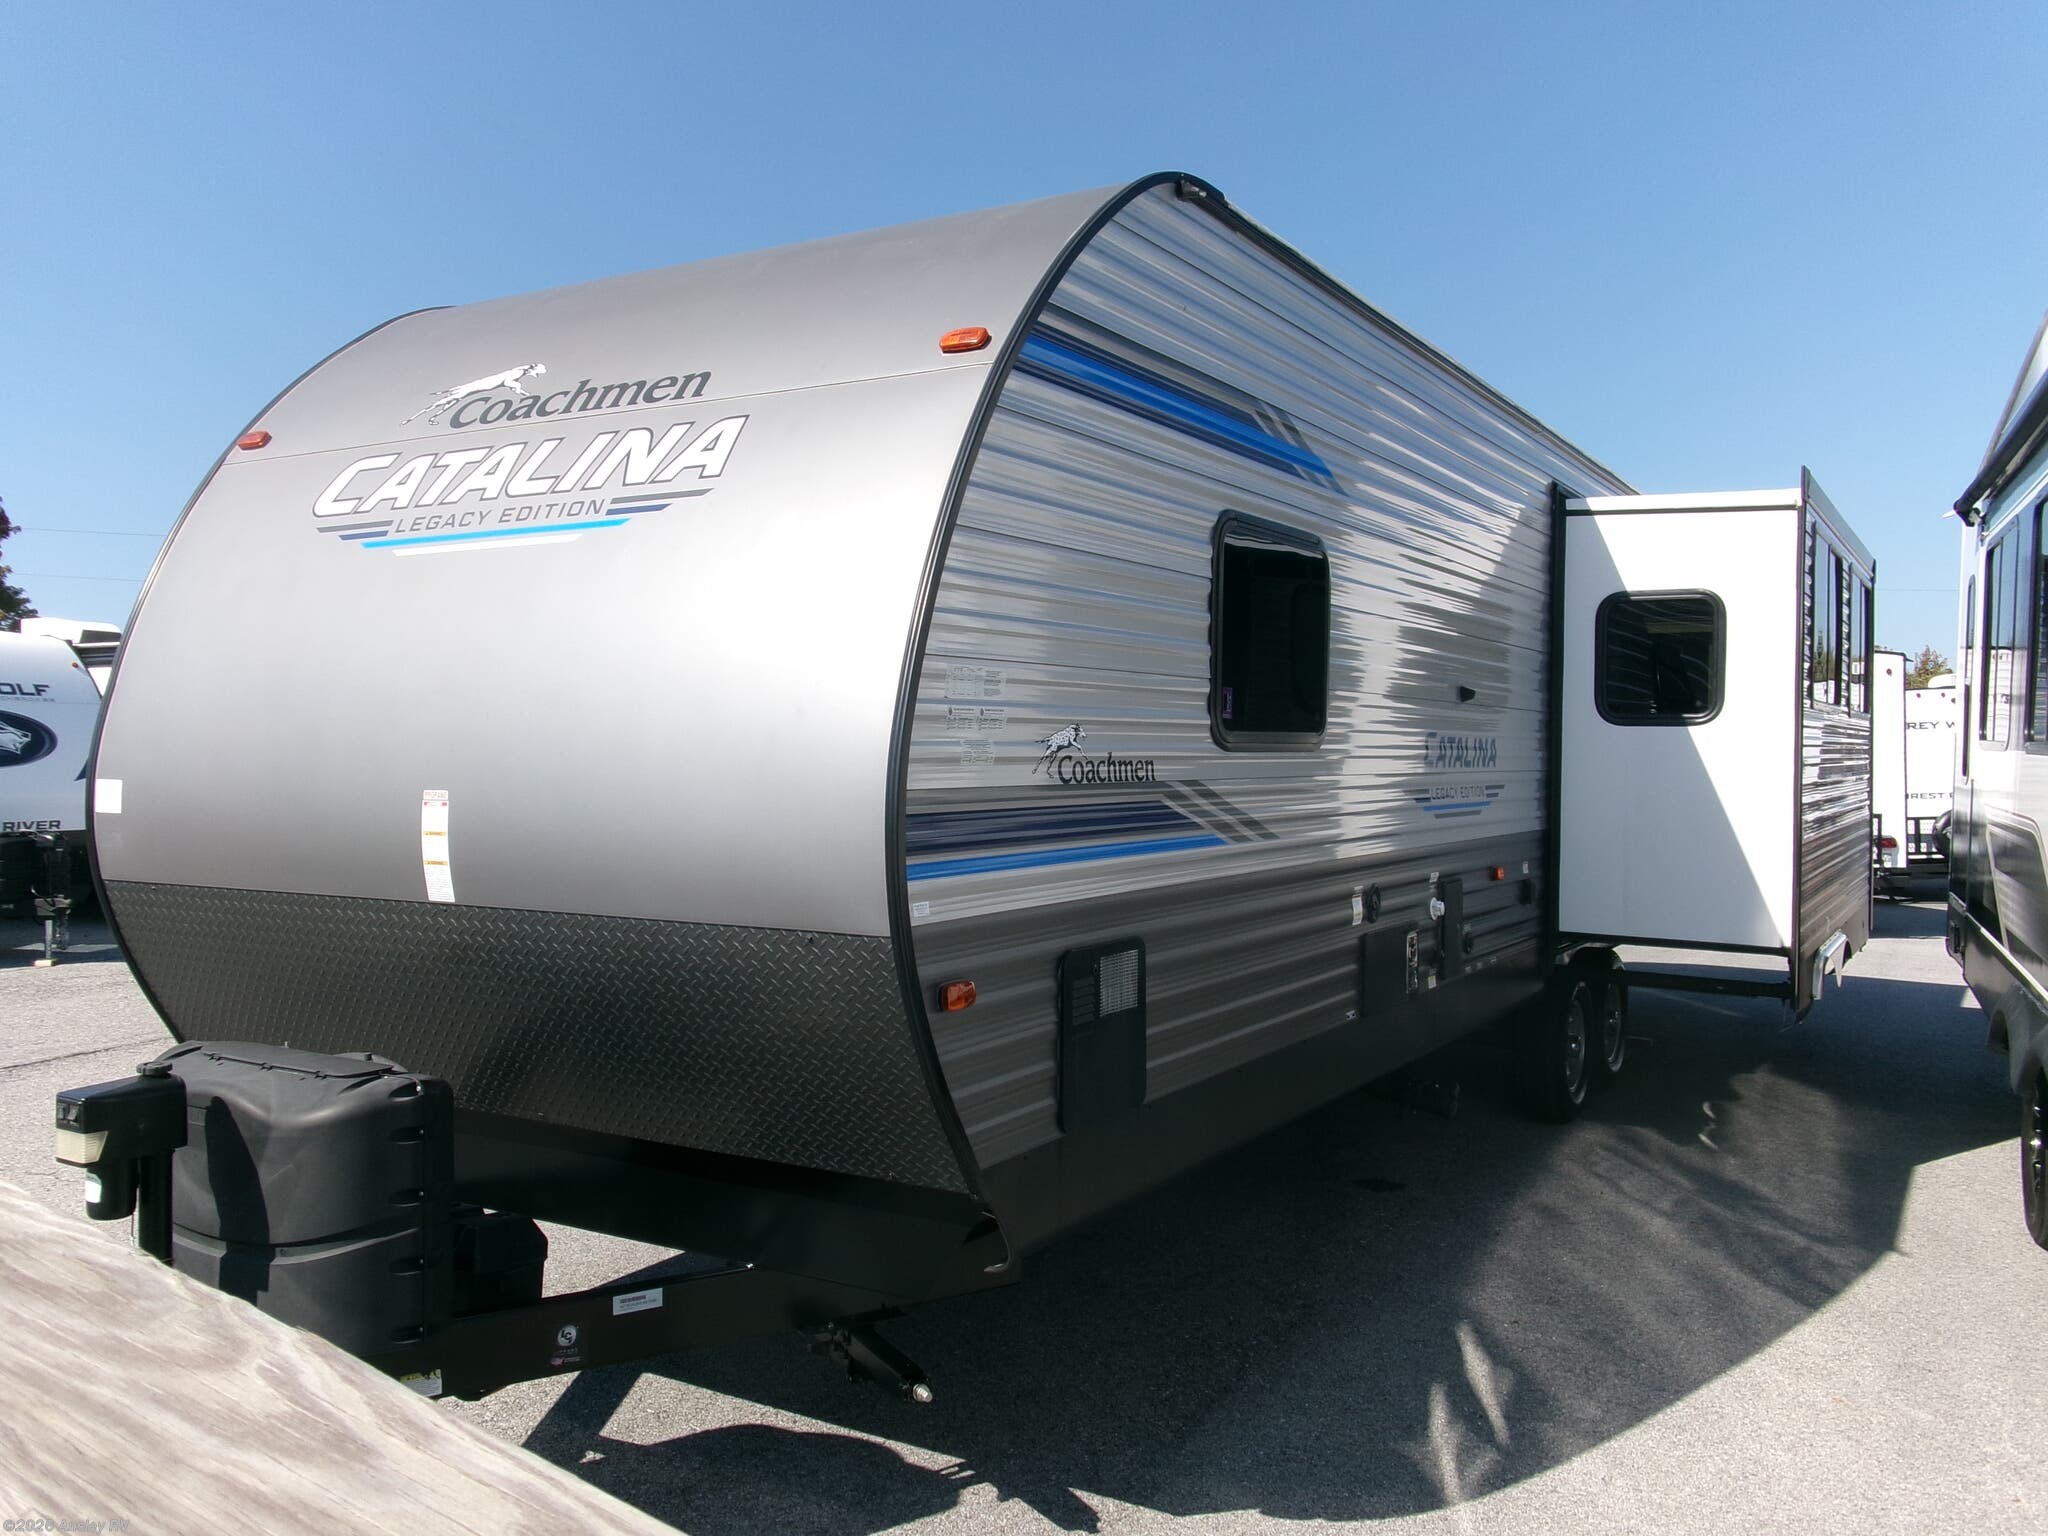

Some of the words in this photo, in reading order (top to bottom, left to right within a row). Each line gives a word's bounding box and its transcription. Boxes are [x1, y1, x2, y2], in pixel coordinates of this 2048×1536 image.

[449, 370, 713, 429] Coachmen
[311, 414, 750, 519] CATALINA
[394, 508, 490, 534] LEGACY
[497, 497, 607, 525] EDITION
[1057, 752, 1156, 785] Coachmen
[1423, 732, 1497, 769] CATALINA
[2, 820, 61, 832] RIVER
